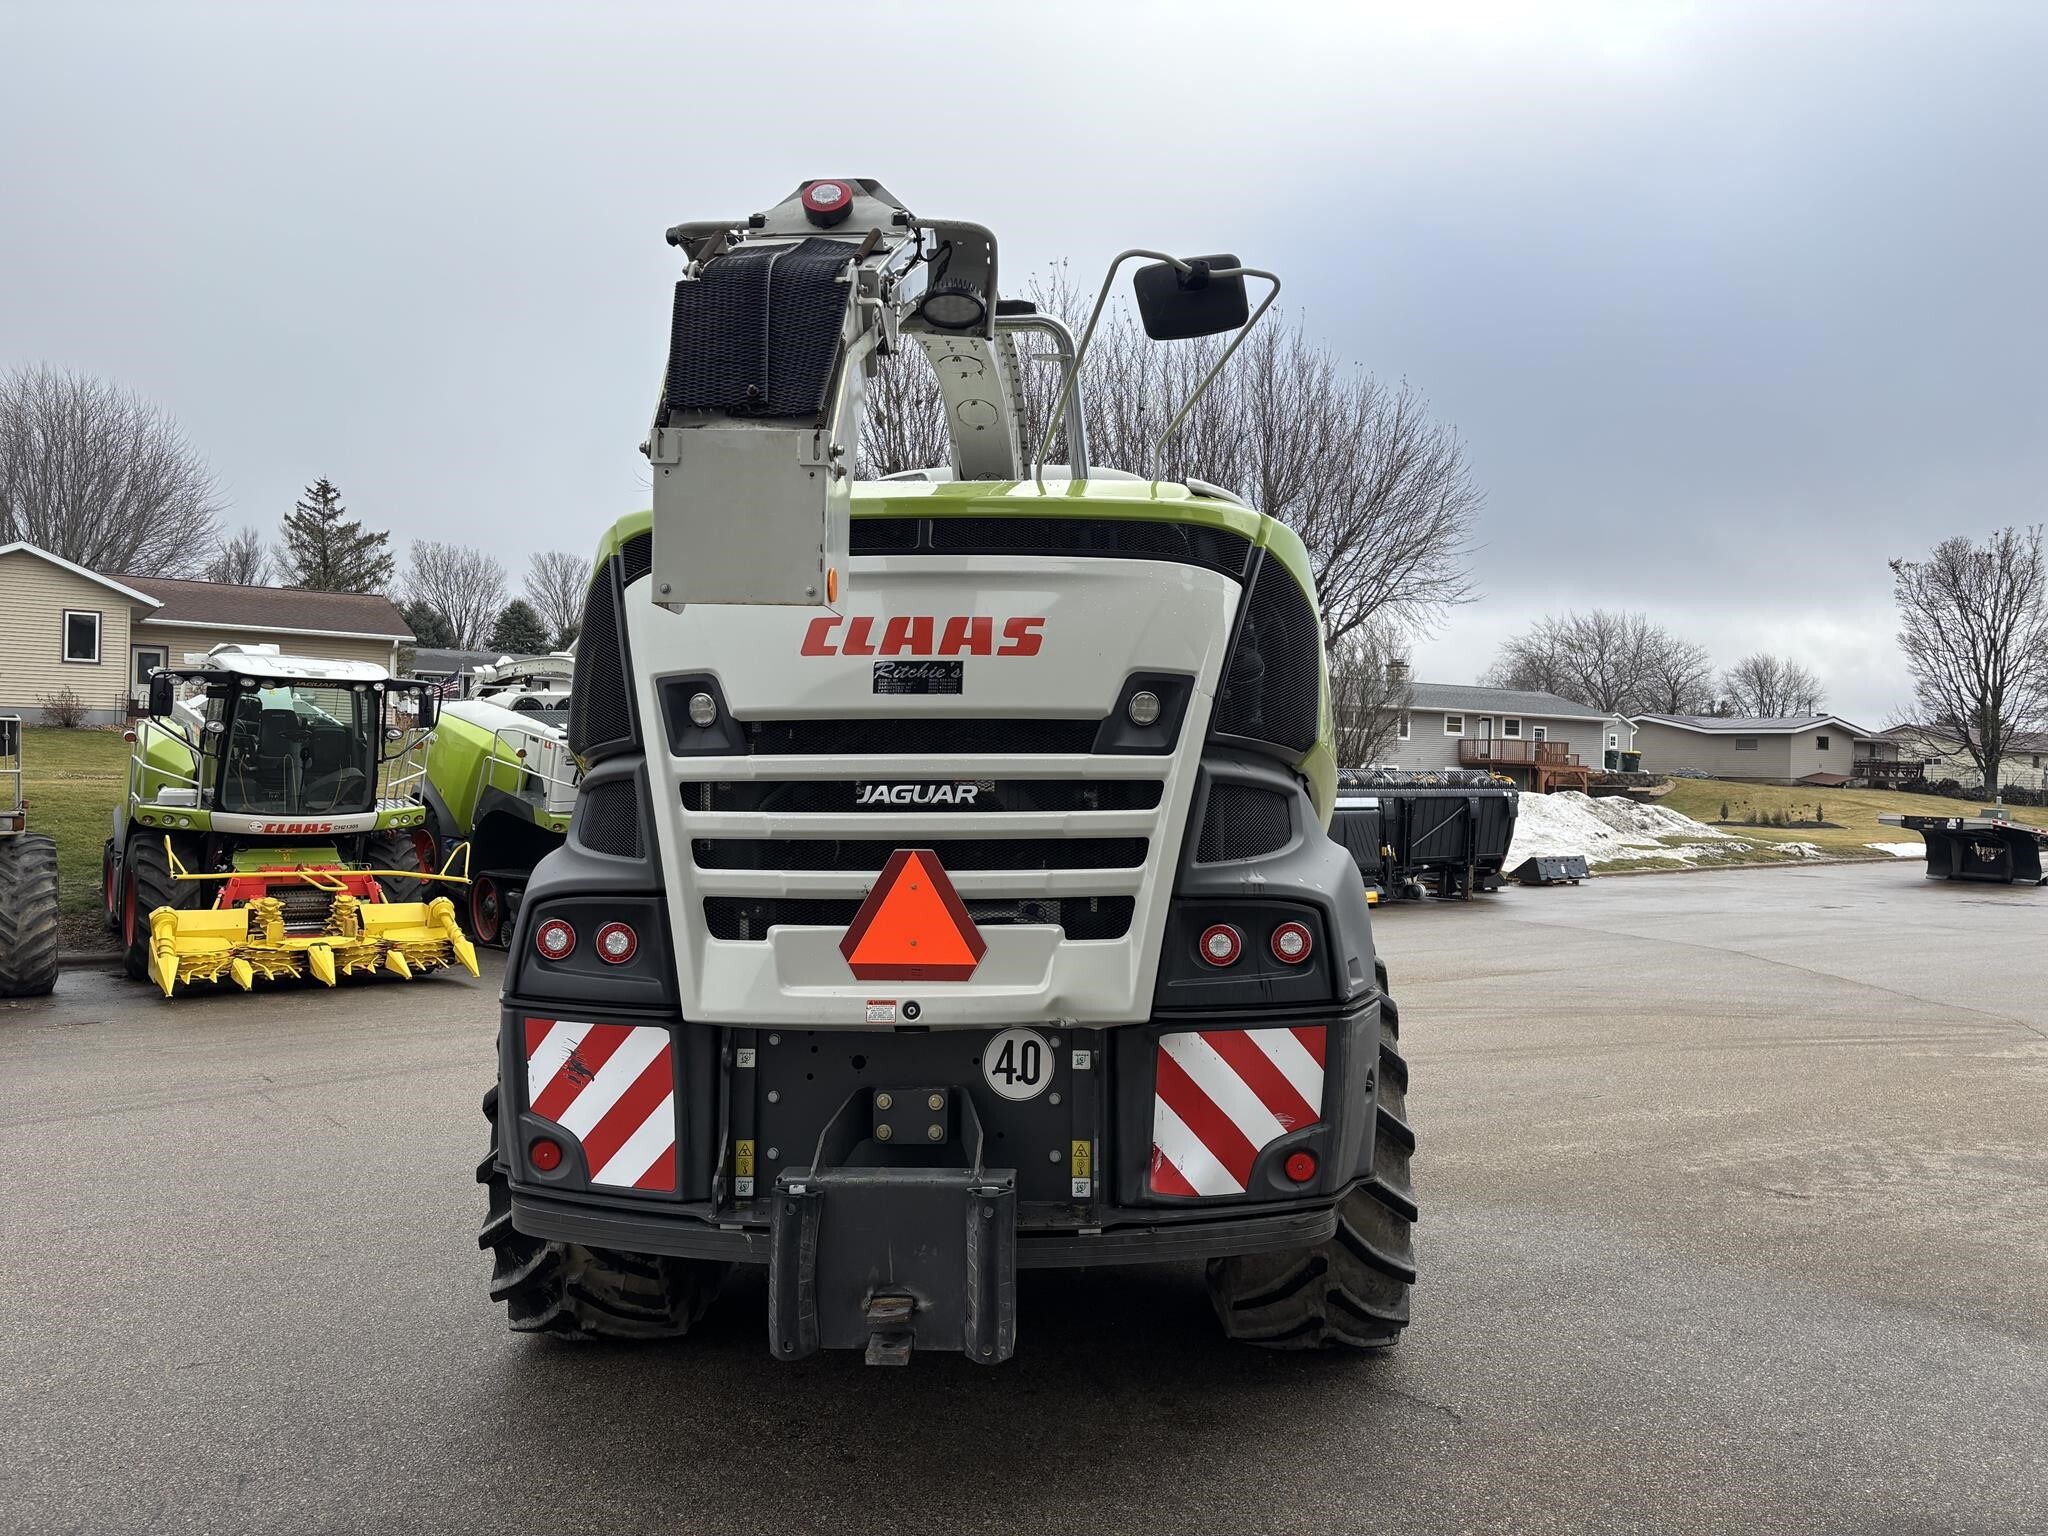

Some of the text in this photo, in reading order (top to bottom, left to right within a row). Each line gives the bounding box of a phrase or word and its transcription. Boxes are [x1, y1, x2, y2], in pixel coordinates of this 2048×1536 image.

[800, 616, 1046, 657] CLAAS
[874, 661, 962, 678] Ritchie's
[856, 784, 979, 804] JAGUAR
[263, 823, 333, 833] CLAAS
[992, 1039, 1041, 1086] 40
